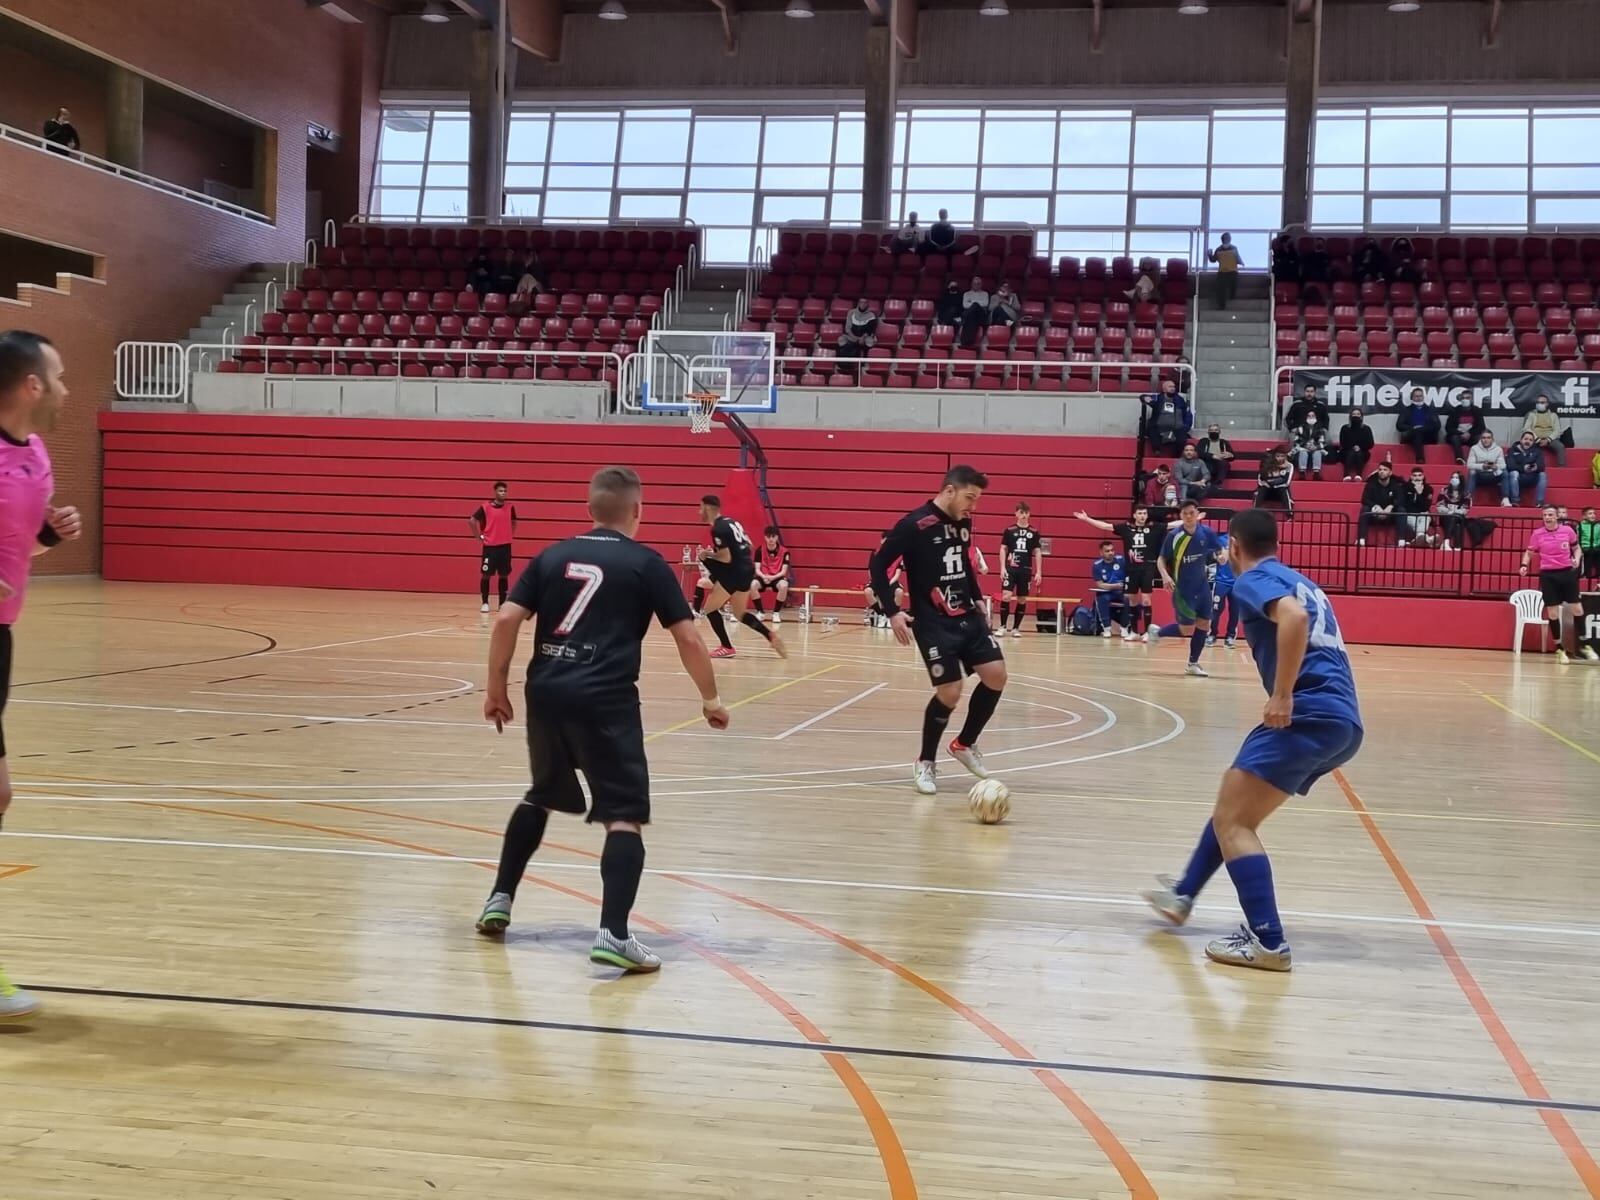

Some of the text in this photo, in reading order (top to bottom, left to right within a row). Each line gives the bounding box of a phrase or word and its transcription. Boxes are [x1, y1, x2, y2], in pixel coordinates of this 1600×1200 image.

[1324, 376, 1516, 409] finetwork
[1561, 377, 1589, 406] fi
[1557, 406, 1597, 414] network
[1015, 537, 1027, 550] fi
[1133, 533, 1145, 545] fi
[942, 545, 963, 574] fi
[554, 562, 604, 634] 7
